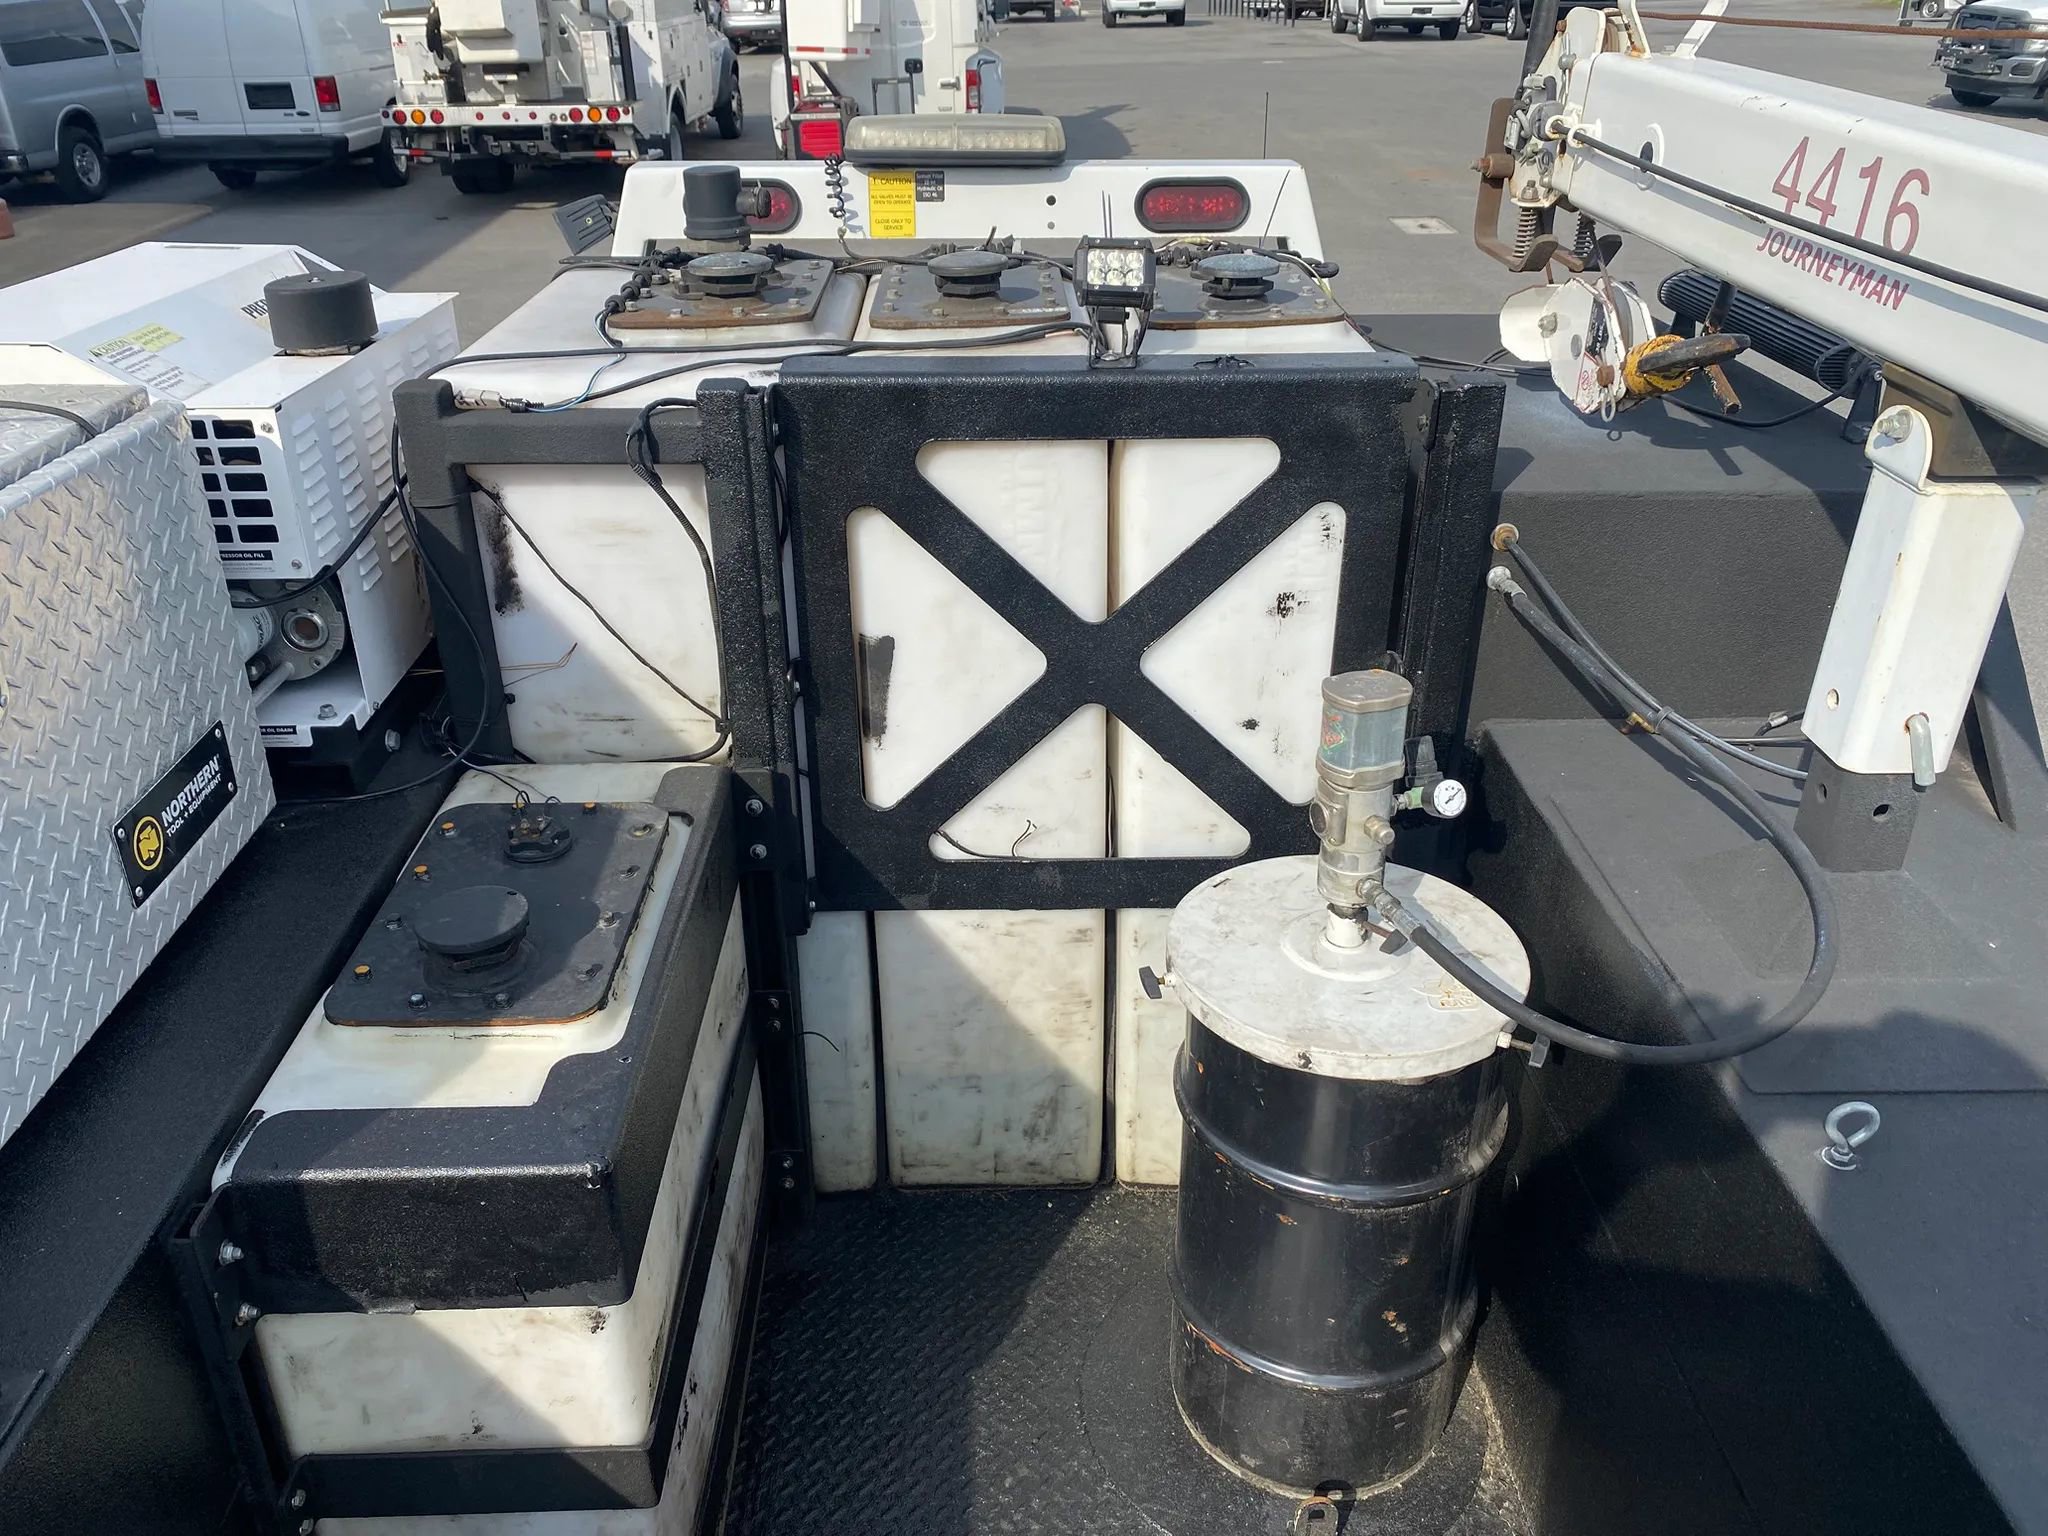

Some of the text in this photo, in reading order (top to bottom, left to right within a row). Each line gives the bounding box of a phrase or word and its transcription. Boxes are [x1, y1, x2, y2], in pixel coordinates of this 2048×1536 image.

[880, 176, 912, 185] CAUTION
[1772, 136, 1930, 256] 4416
[1756, 228, 1910, 311] JOURNEYMAN
[161, 756, 219, 828] NORTHERN
[166, 818, 185, 838] TOOL
[188, 773, 222, 815] EQUIPMENT
